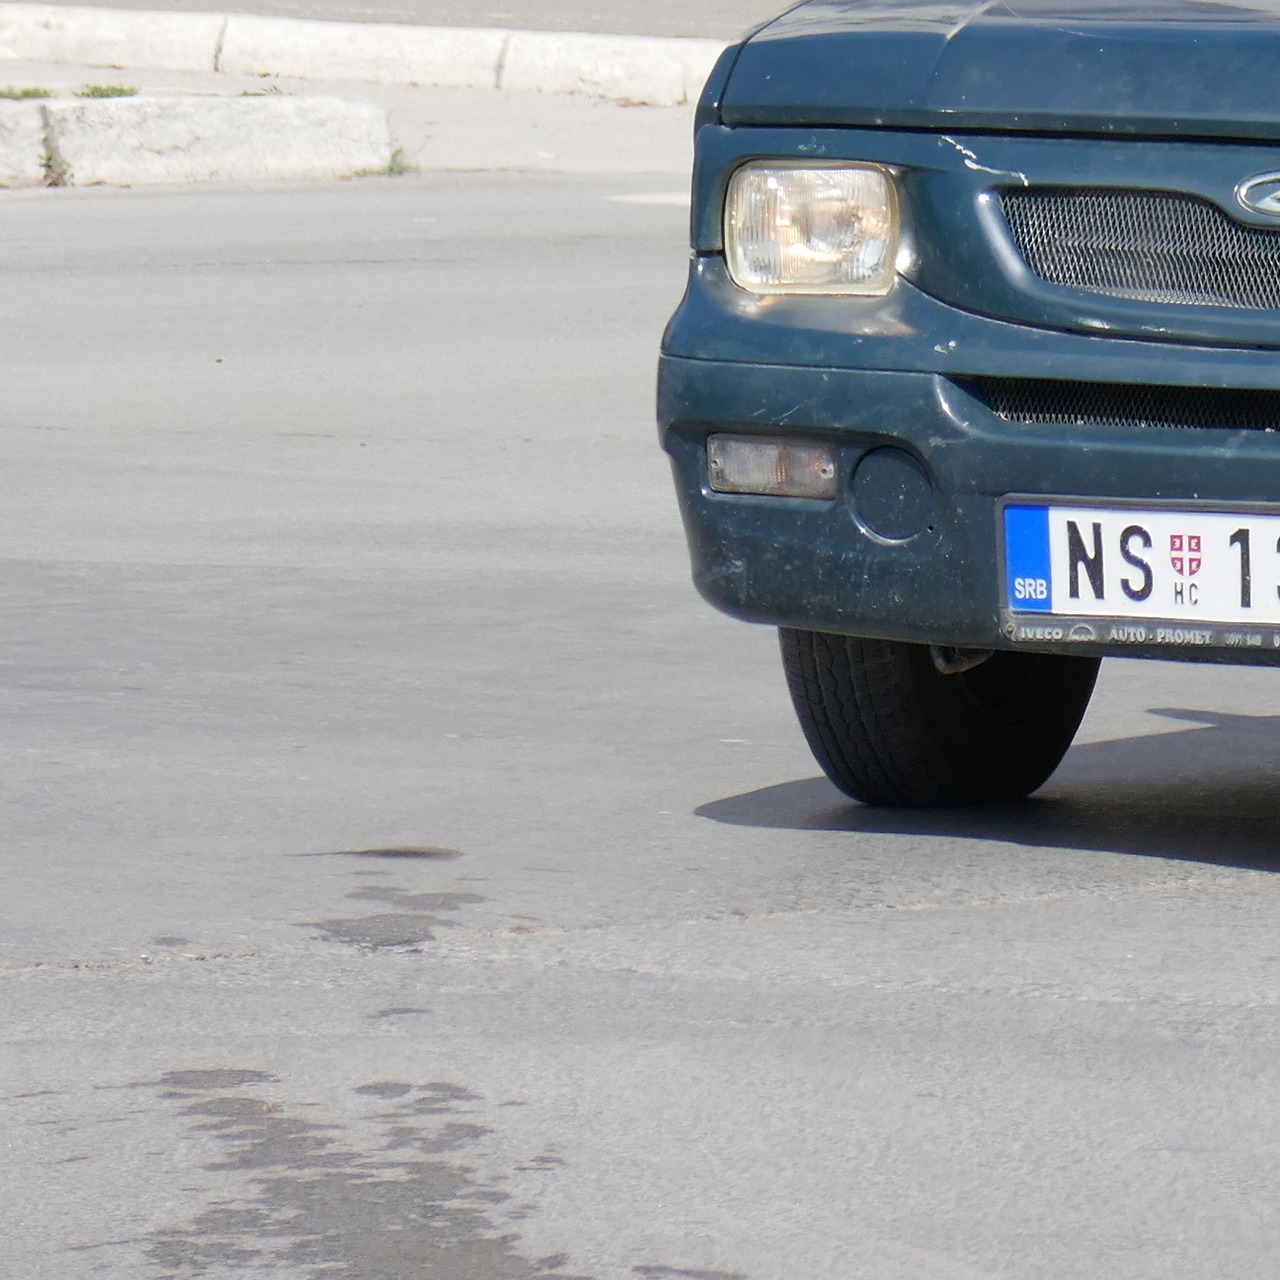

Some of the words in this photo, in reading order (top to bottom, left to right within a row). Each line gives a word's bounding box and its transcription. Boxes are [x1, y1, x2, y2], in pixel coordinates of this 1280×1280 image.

[1066, 519, 1154, 602] NS
[1014, 578, 1047, 600] SRB
[1021, 627, 1063, 640] IVECO
[1109, 627, 1146, 644] AUTO
[1157, 628, 1214, 646] PROMET
